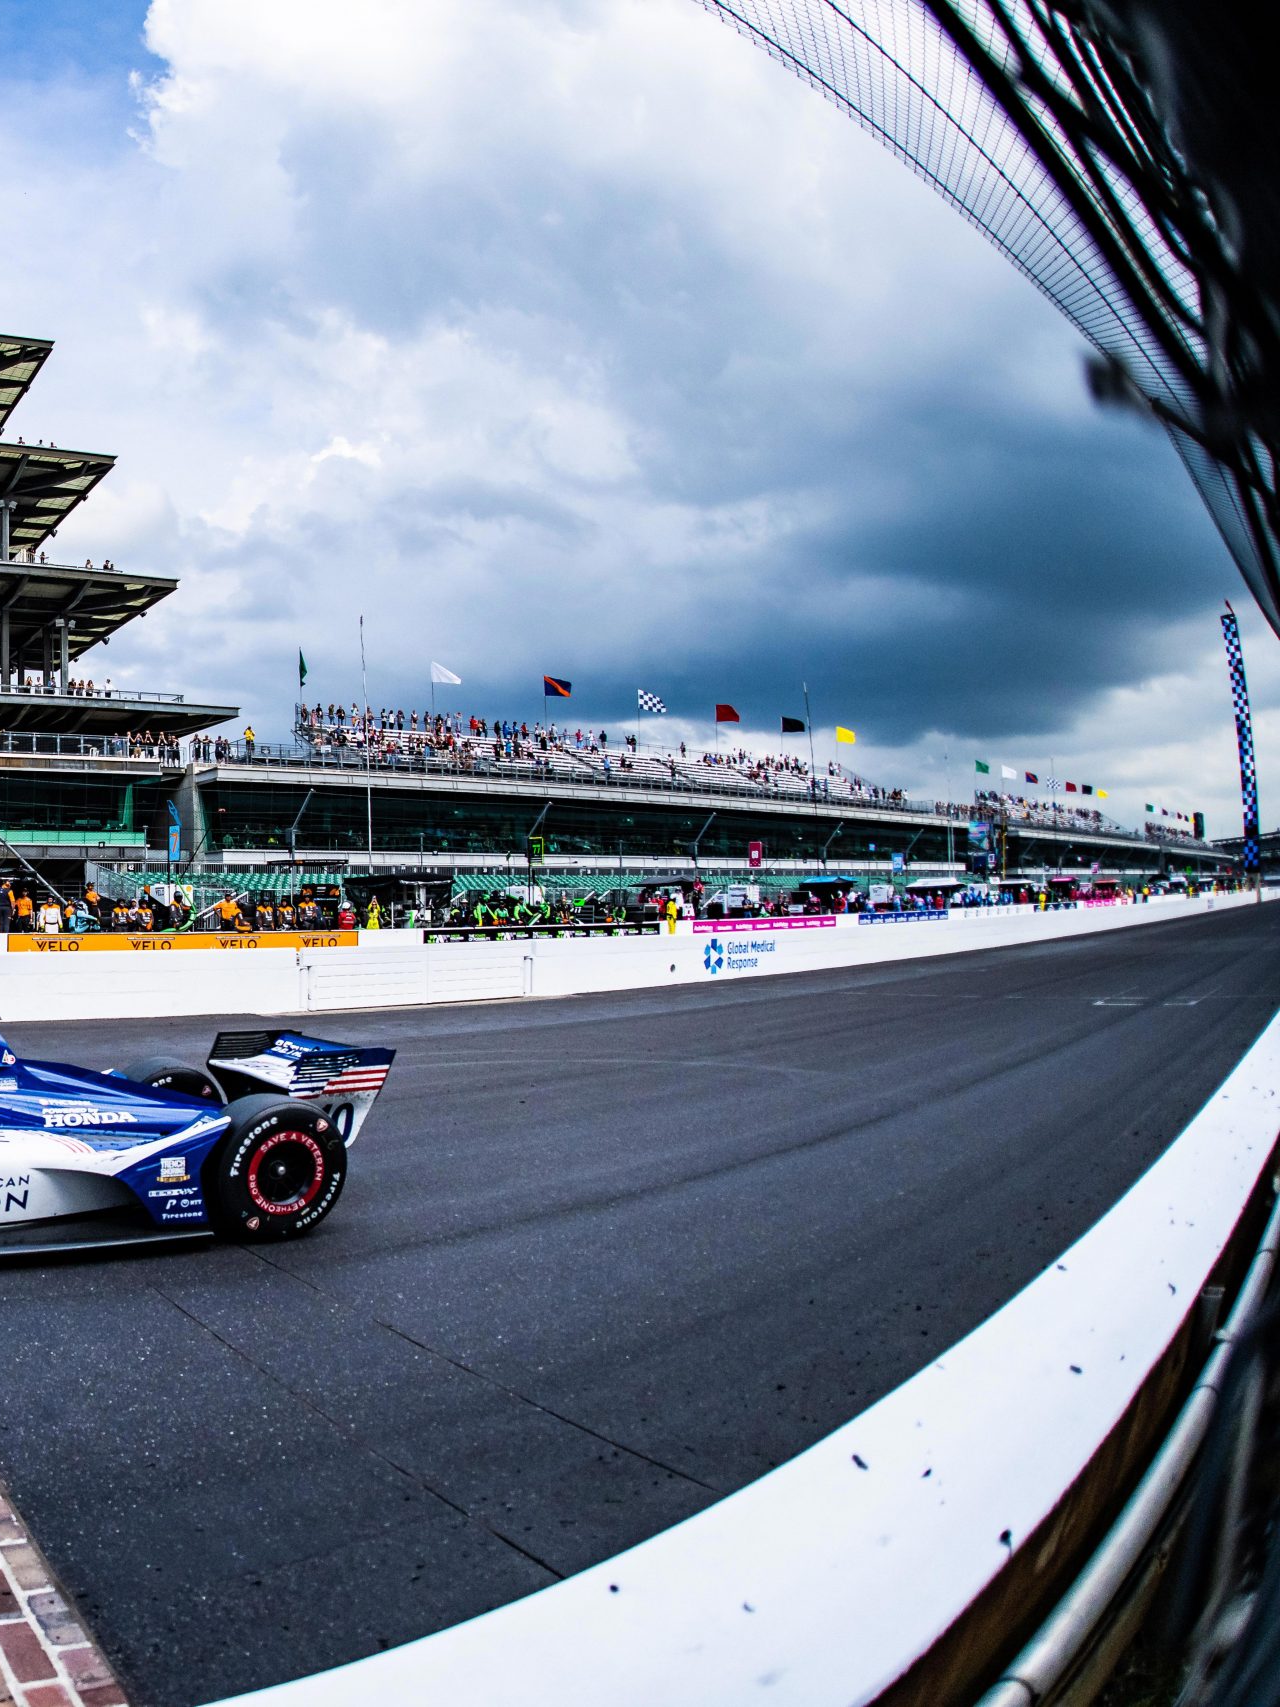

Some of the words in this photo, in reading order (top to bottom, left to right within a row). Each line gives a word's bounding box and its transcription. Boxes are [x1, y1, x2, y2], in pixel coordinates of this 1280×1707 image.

[171, 833, 178, 852] 7
[532, 844, 541, 853] 77
[36, 941, 80, 951] VELO
[727, 941, 749, 955] Global
[751, 940, 776, 953] Medical
[727, 956, 759, 972] Response
[43, 1112, 138, 1127] HONDA
[230, 1116, 278, 1177] Firestone
[260, 1133, 287, 1152] SAVE
[301, 1135, 324, 1181] VETERAN
[296, 1172, 340, 1228] Firestone
[162, 1211, 203, 1220] Firestone
